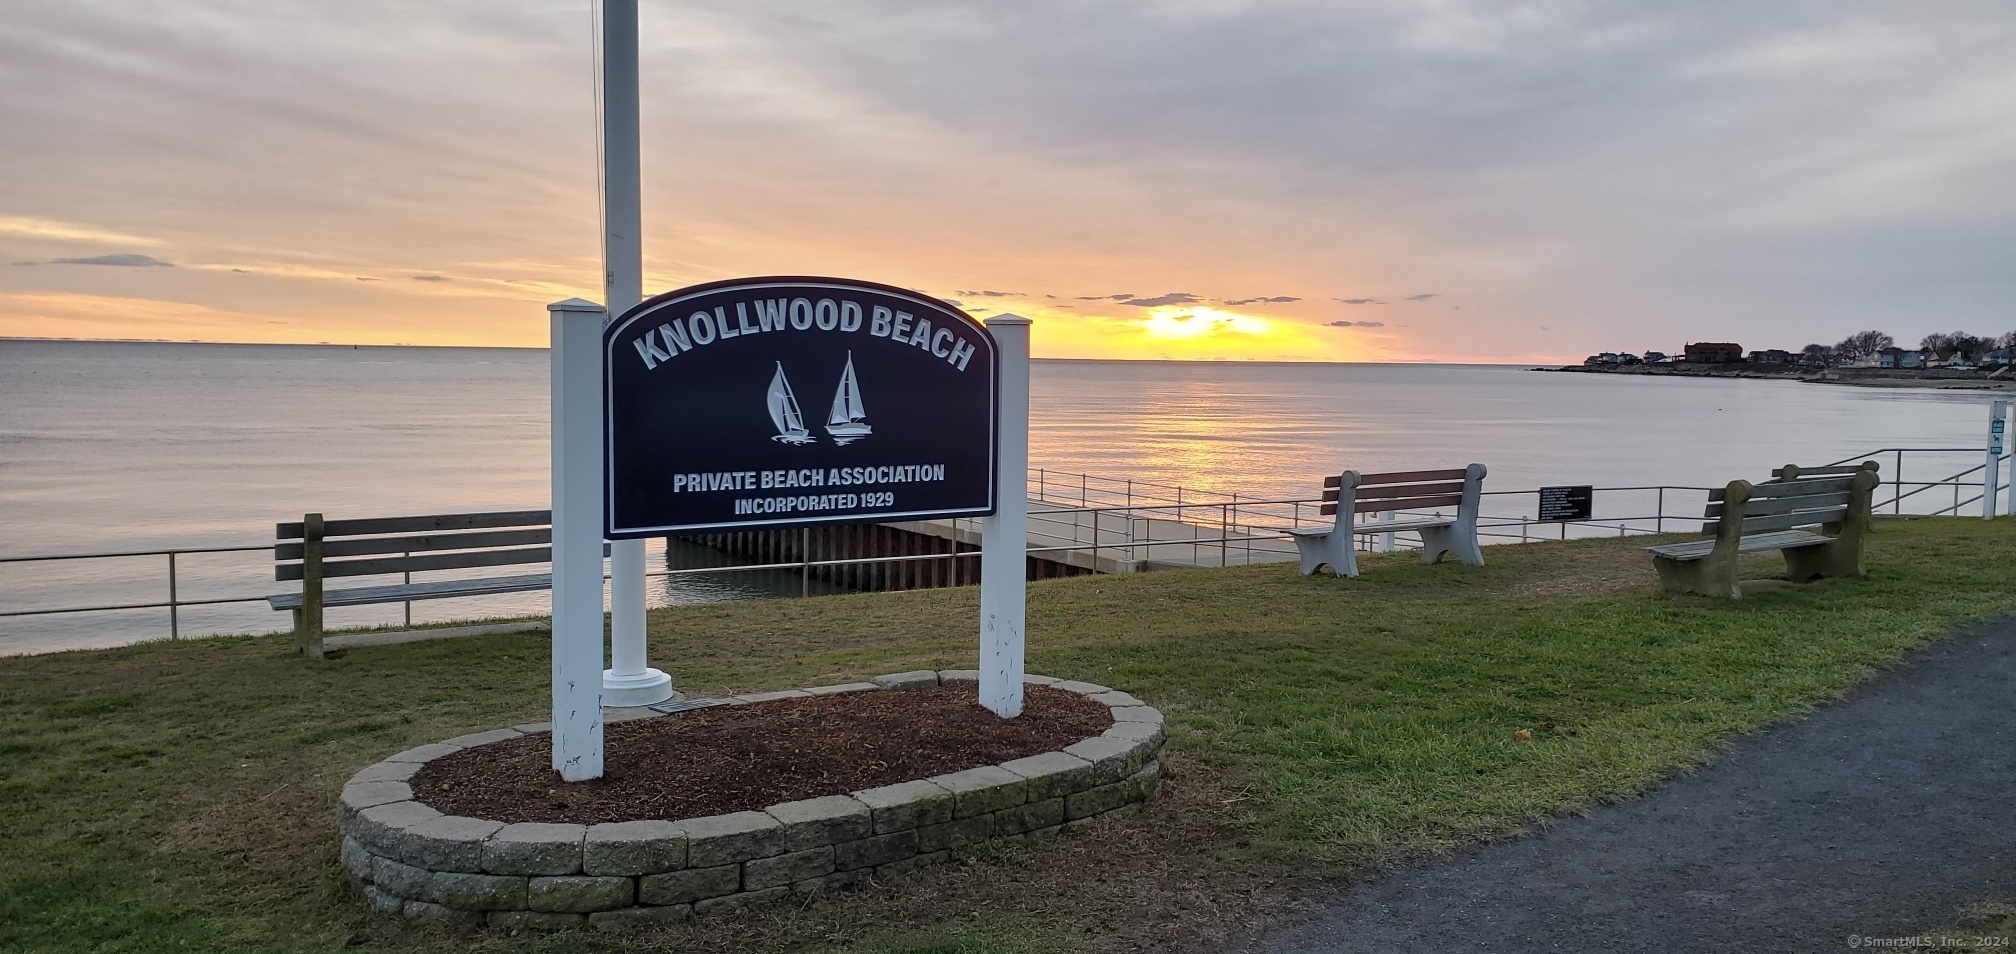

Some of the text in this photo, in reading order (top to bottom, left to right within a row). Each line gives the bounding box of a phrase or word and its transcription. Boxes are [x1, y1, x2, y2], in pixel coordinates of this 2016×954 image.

[633, 297, 976, 373] KNOLLWOOD BEACH
[673, 464, 945, 493] PRIVATE BEACH ASSOCIATION
[734, 492, 894, 515] INCORPORATED 1929
